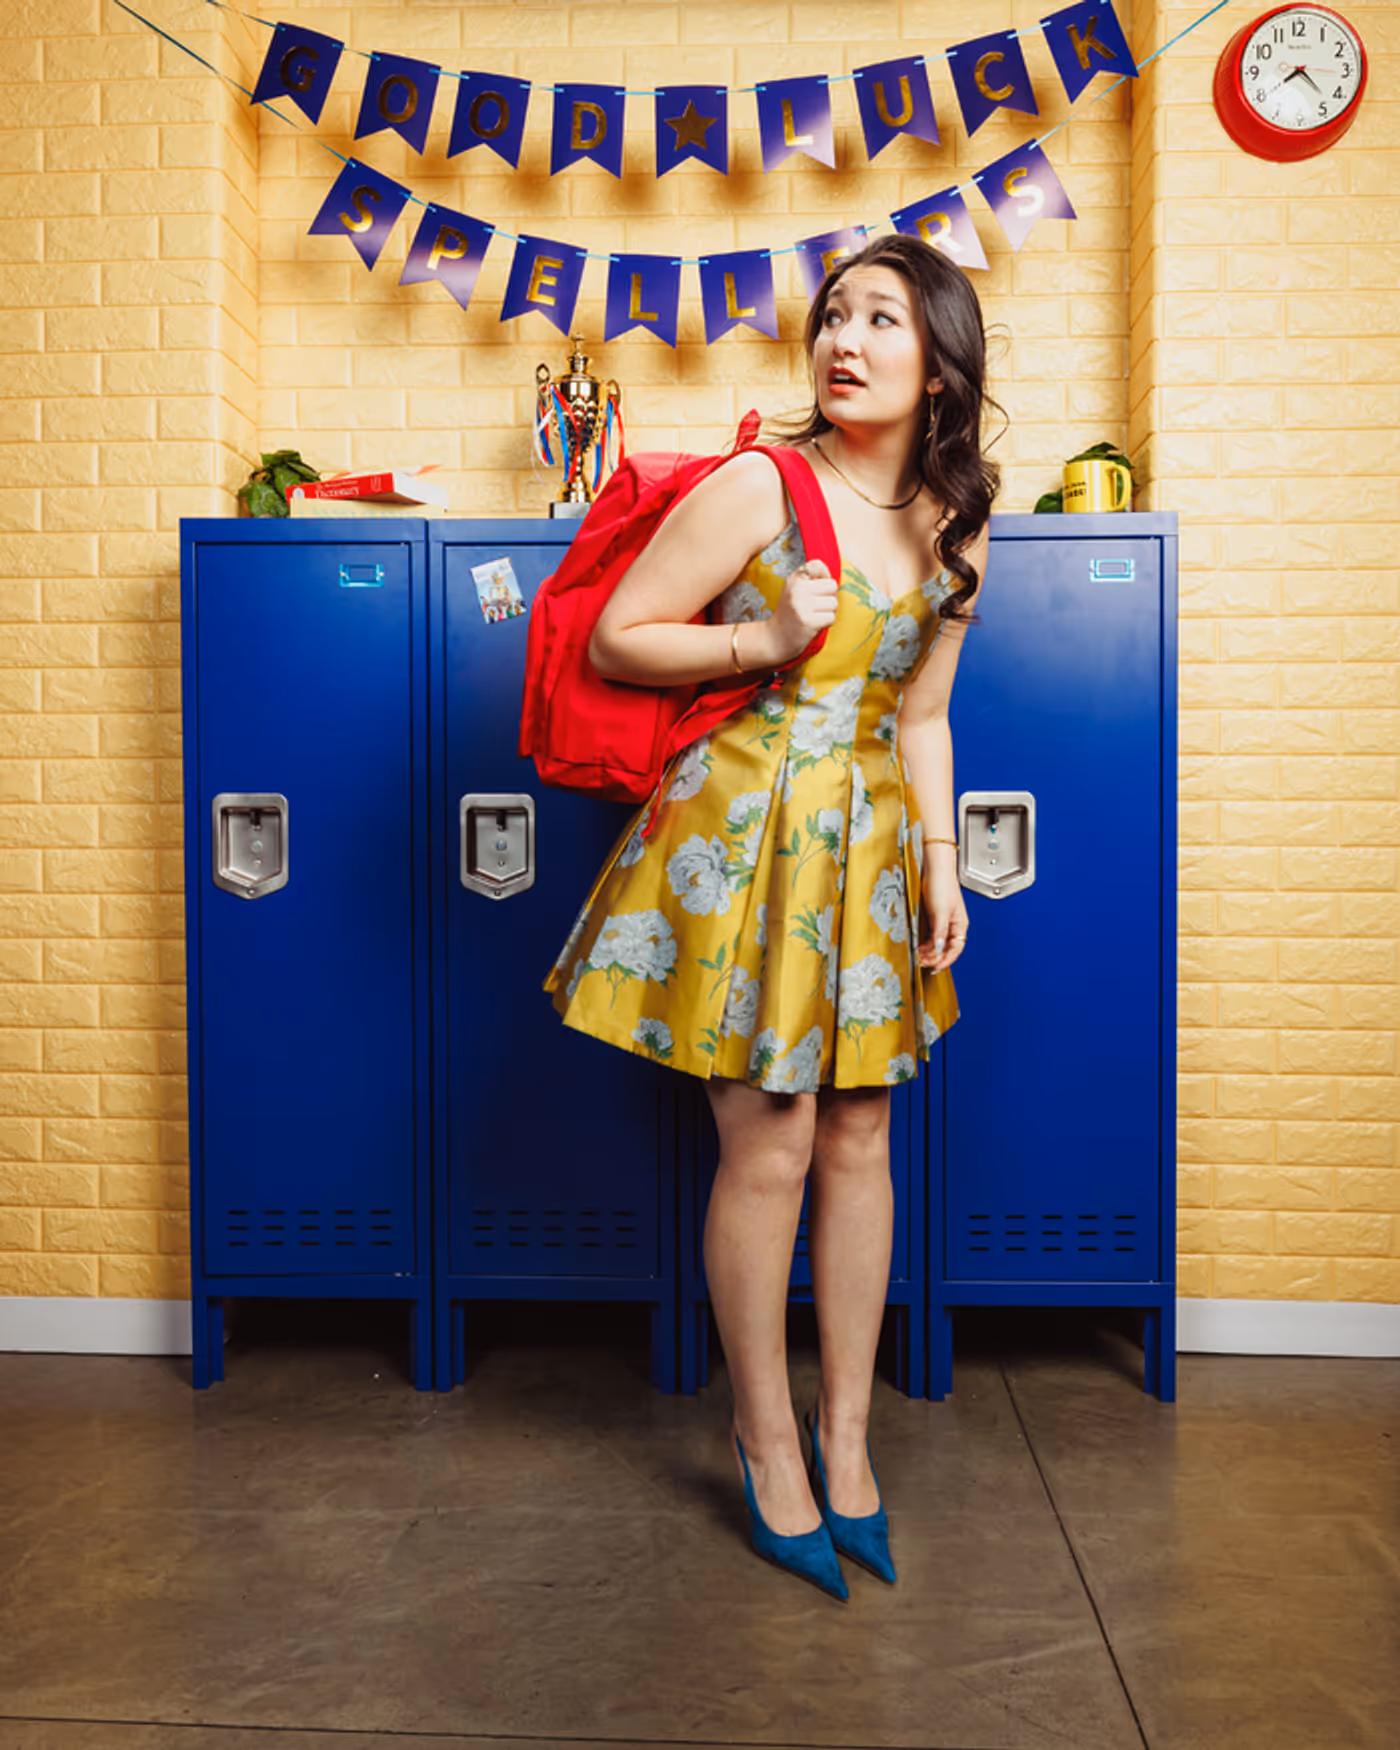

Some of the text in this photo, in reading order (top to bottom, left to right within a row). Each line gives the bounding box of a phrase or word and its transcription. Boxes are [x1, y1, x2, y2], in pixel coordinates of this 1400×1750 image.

[1273, 28, 1284, 43] 11
[1291, 21, 1306, 37] 12
[1320, 27, 1325, 43] 1
[1256, 43, 1272, 60] 10
[1334, 41, 1345, 58] 2
[1249, 65, 1260, 80] 9
[1341, 62, 1350, 79] 3
[278, 15, 1118, 151] GOOD LUCK
[1256, 88, 1267, 103] 8
[1332, 85, 1343, 100] 4
[1318, 102, 1328, 117] 5
